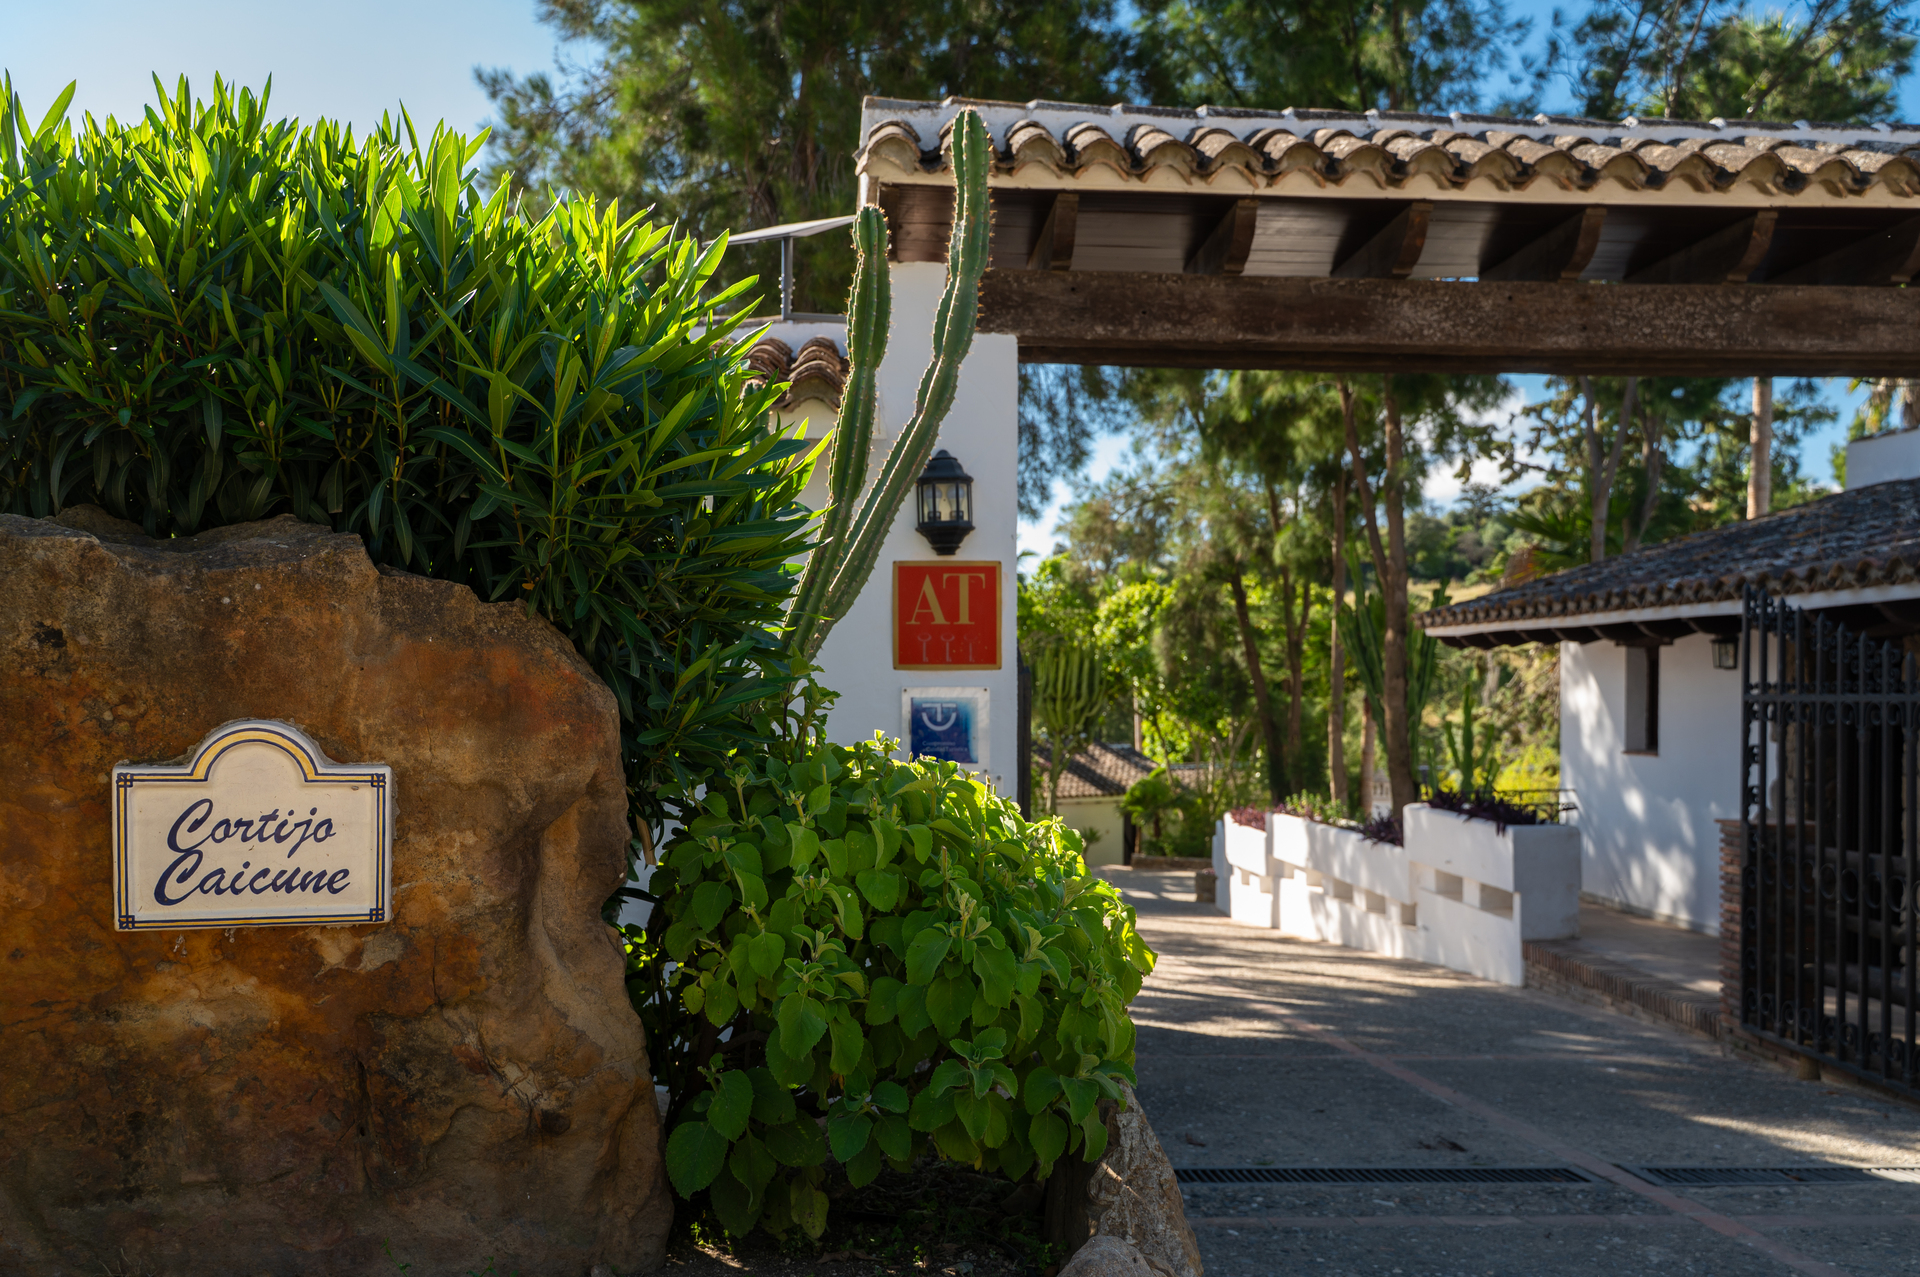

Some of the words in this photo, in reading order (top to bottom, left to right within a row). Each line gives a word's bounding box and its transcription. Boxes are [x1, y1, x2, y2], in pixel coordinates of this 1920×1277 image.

[905, 573, 985, 625] AT
[167, 798, 336, 858] Cortijo
[153, 849, 350, 906] Caicune
